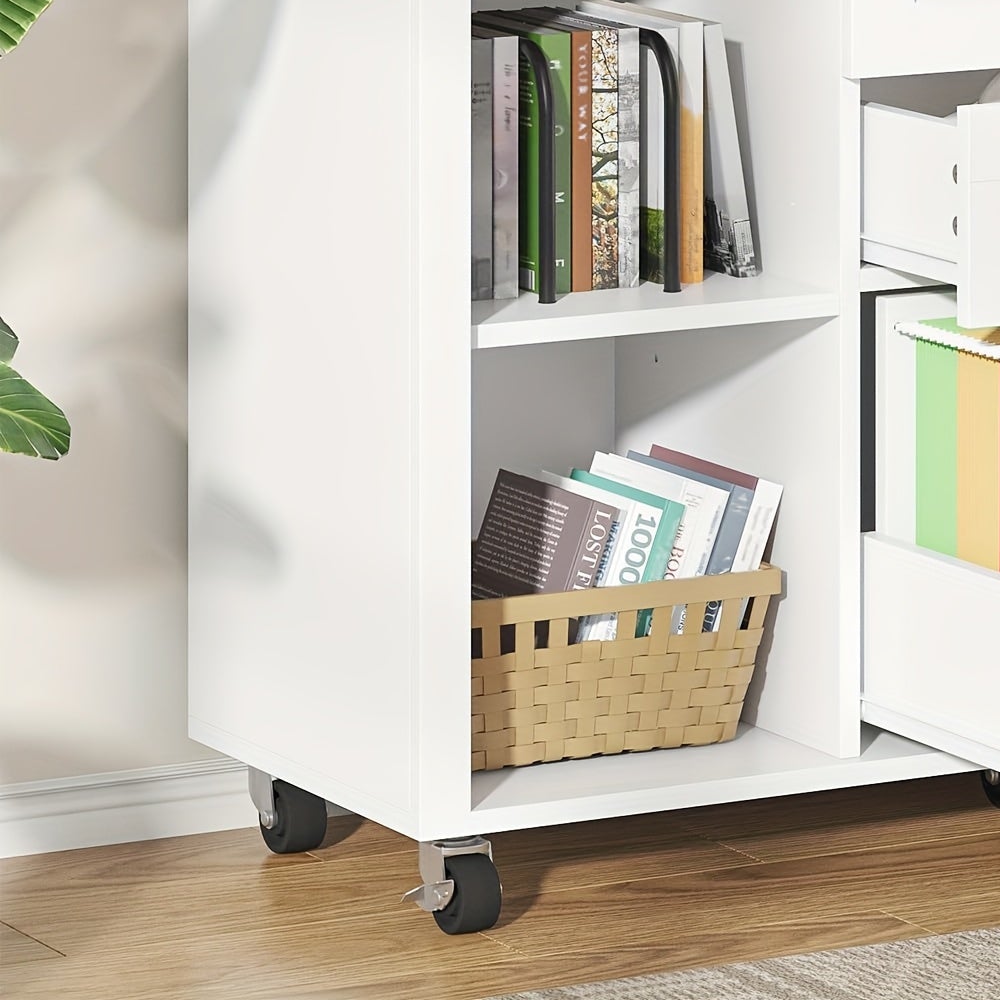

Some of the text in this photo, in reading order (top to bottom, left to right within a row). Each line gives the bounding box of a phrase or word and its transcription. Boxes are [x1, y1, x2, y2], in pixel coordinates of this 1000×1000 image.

[577, 43, 589, 141] YOUR WAY
[582, 509, 612, 569] LOST
[618, 513, 657, 585] 1000
